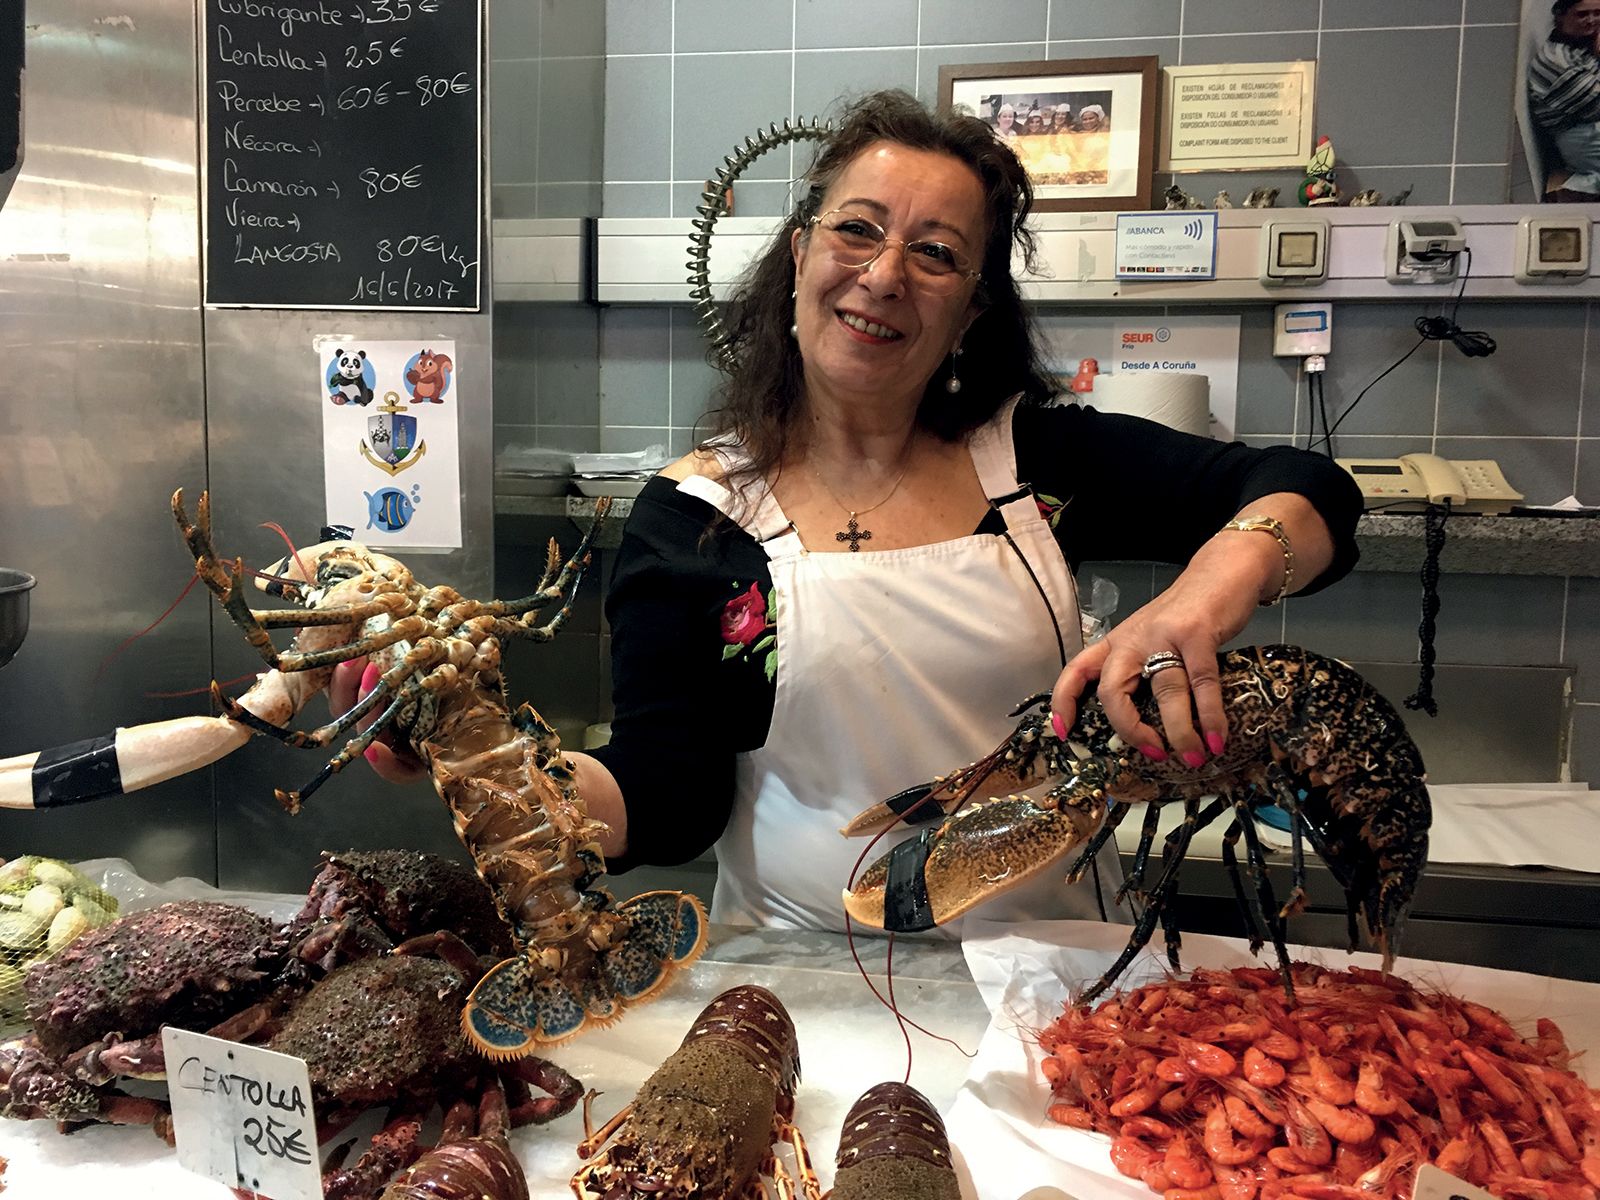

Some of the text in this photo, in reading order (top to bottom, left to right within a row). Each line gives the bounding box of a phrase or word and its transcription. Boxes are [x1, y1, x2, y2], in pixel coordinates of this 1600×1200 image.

[218, 24, 312, 70] Centolla
[216, 80, 301, 113] Percebe
[1182, 85, 1204, 93] EXISTEN
[1208, 83, 1225, 91] HOJAS
[1229, 83, 1237, 91] DE
[1181, 112, 1203, 120] EXISTEN
[1231, 110, 1238, 118] DE
[225, 120, 302, 152] Nécora
[1179, 139, 1205, 147] COMPLAINT
[224, 158, 317, 197] Camarón
[226, 197, 285, 227] Vieira
[1127, 227, 1165, 235] ABANCA
[234, 233, 341, 265] LANGOSTA
[1122, 333, 1154, 343] SEUR
[1121, 361, 1196, 370] Desde A Coruña
[178, 1056, 306, 1117] CENTOLLA
[243, 1115, 312, 1165] 25€
